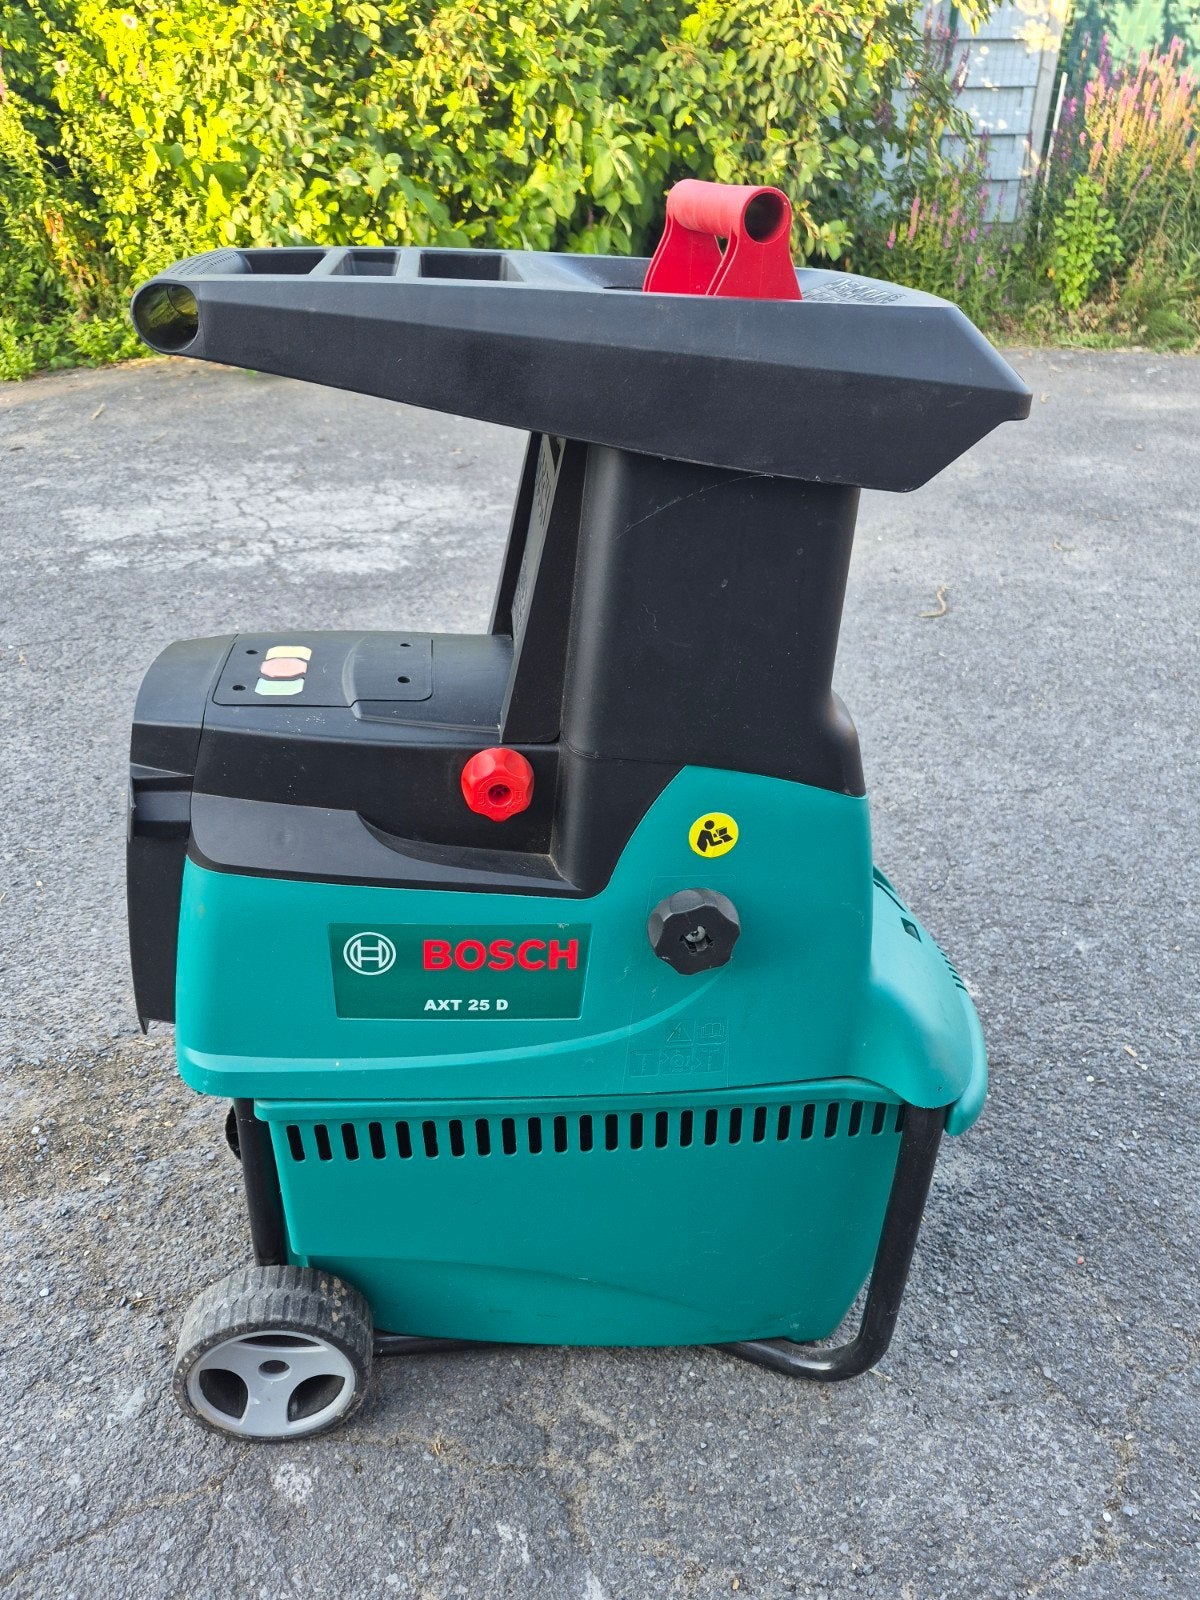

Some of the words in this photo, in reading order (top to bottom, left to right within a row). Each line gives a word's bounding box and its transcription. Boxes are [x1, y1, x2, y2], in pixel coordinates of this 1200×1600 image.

[423, 939, 579, 970] BOSCH
[424, 999, 463, 1011] AXT
[468, 999, 490, 1011] 25
[496, 999, 509, 1011] D
